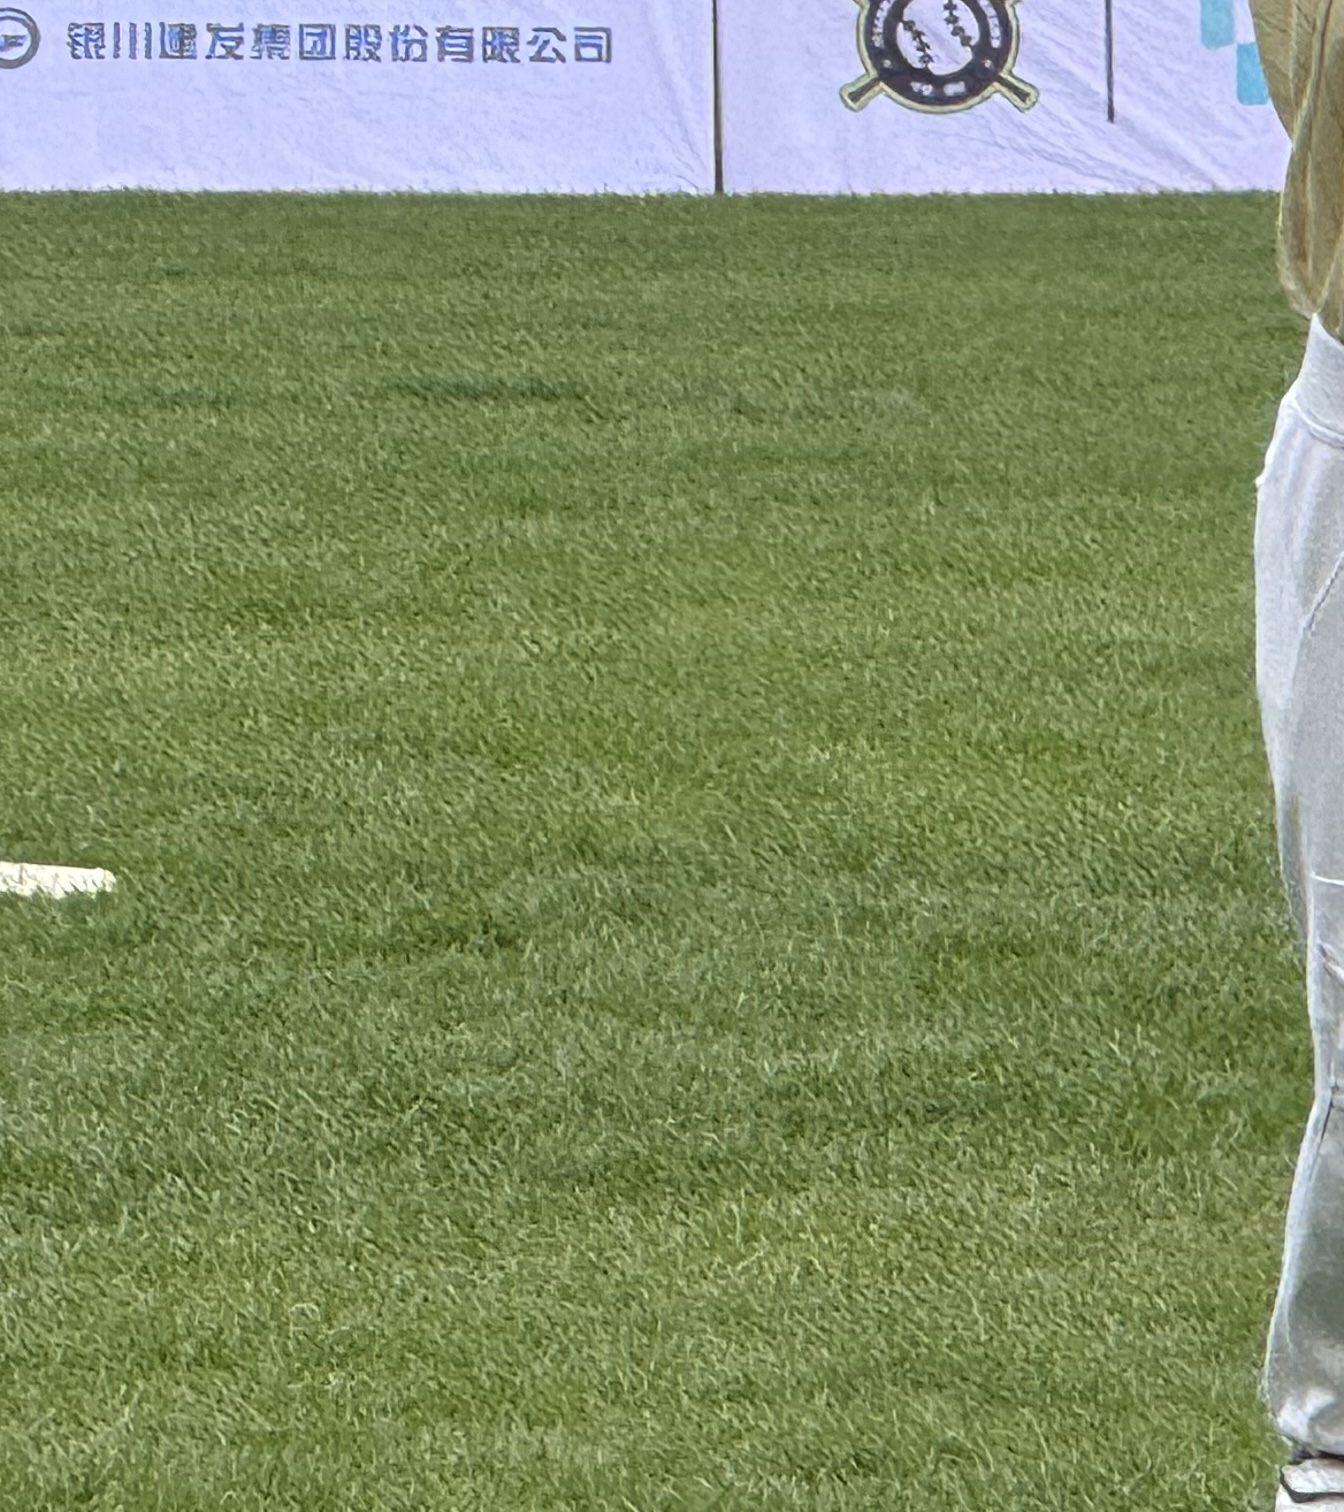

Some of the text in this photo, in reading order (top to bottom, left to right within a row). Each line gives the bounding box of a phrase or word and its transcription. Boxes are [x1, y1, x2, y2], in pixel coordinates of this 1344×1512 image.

[66, 21, 613, 64] 银川建发集团股份有限公司
